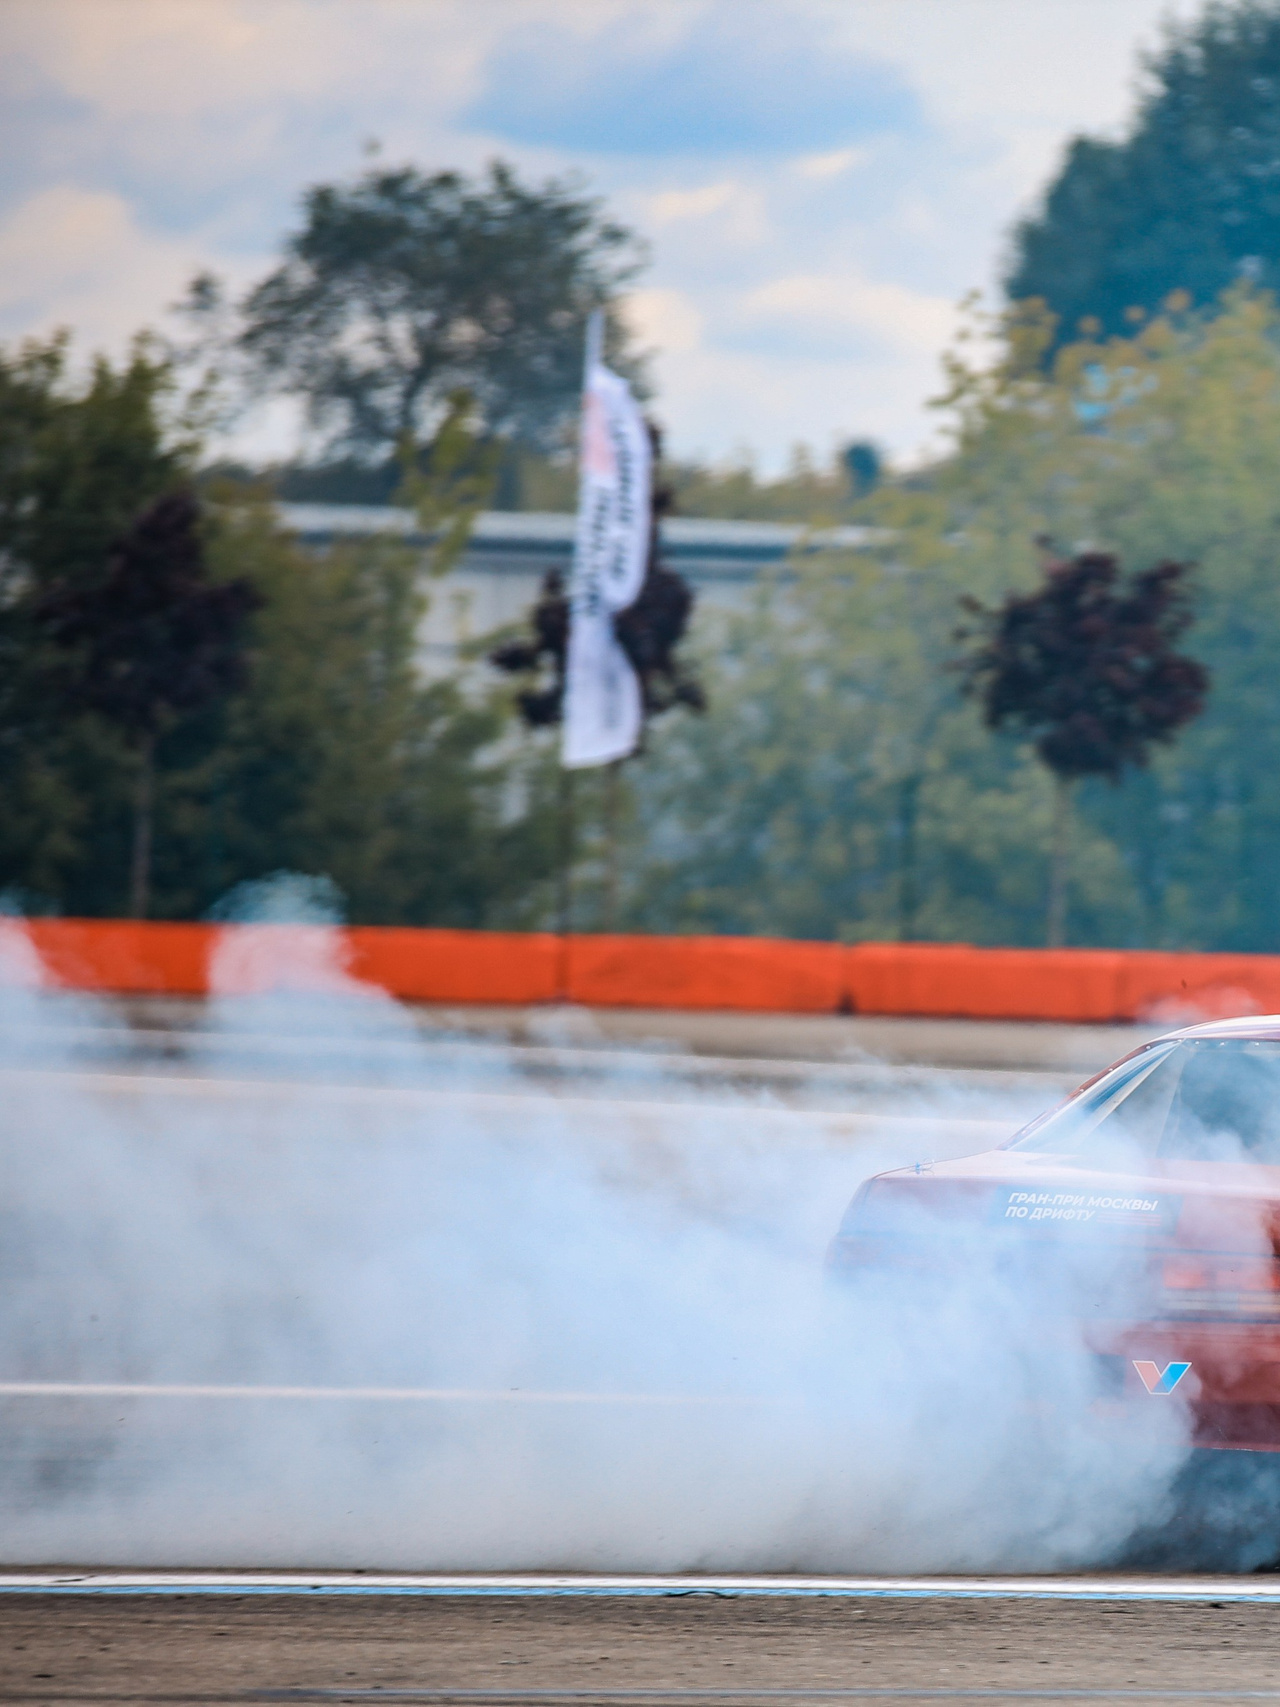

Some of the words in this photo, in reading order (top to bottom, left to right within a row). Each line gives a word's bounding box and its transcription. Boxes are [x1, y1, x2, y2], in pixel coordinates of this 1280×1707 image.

[1008, 1192, 1085, 1206] ГРАН-ПРИ
[1087, 1196, 1159, 1212] МОСКВЫ
[1005, 1206, 1028, 1218] ПО
[1029, 1207, 1095, 1221] ДРИФТУ
